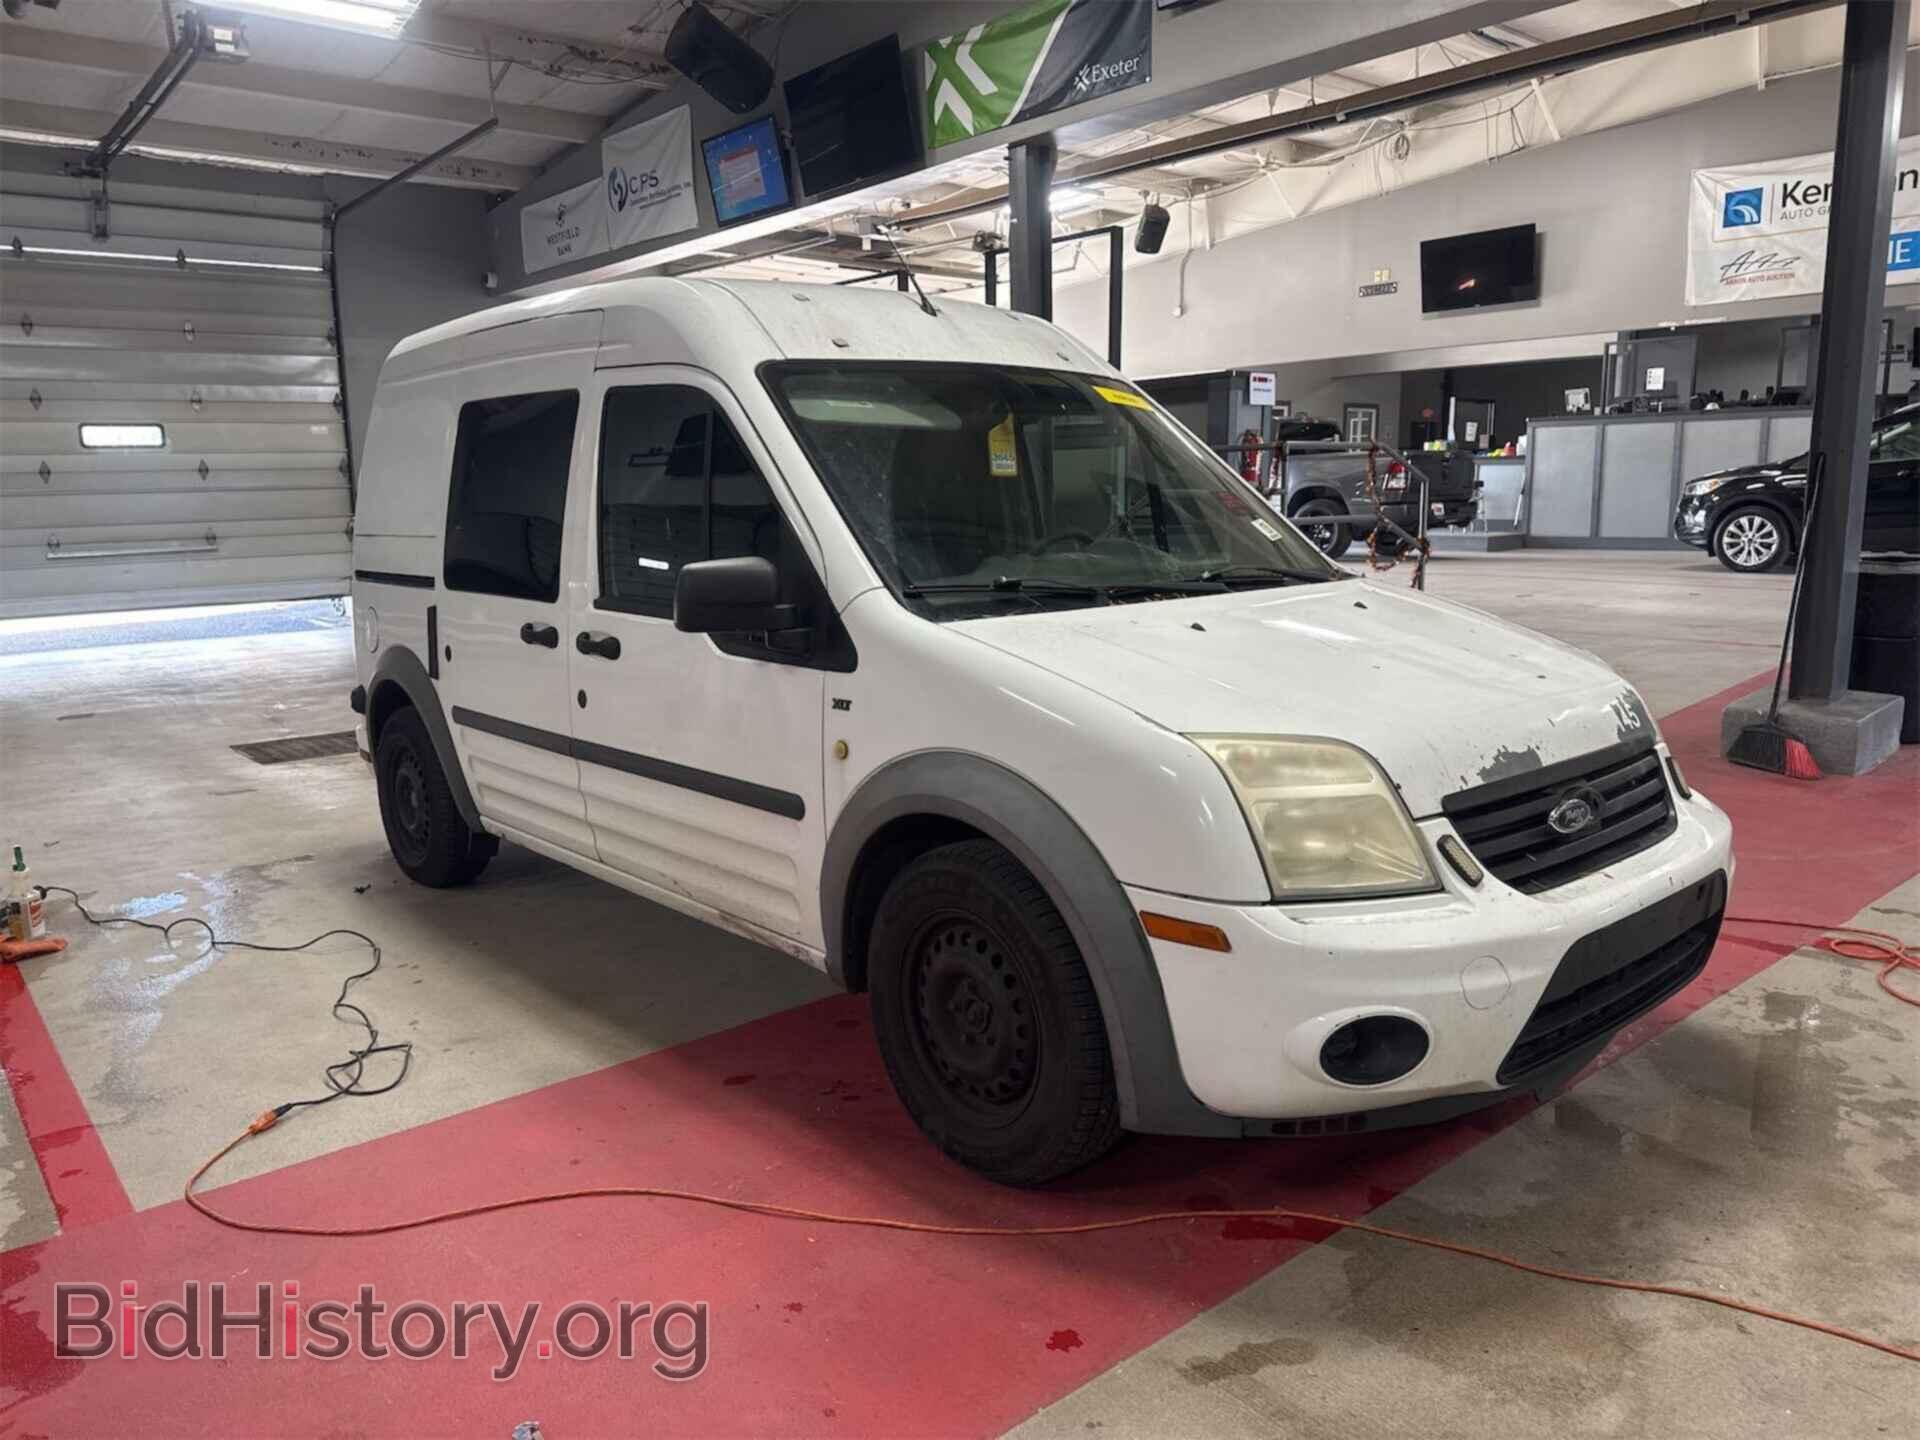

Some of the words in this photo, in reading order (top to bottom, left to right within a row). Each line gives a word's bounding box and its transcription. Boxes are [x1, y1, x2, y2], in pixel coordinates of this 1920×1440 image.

[1091, 57, 1140, 82] Exeter
[628, 169, 659, 194] CPS
[1780, 207, 1814, 220] AUTO
